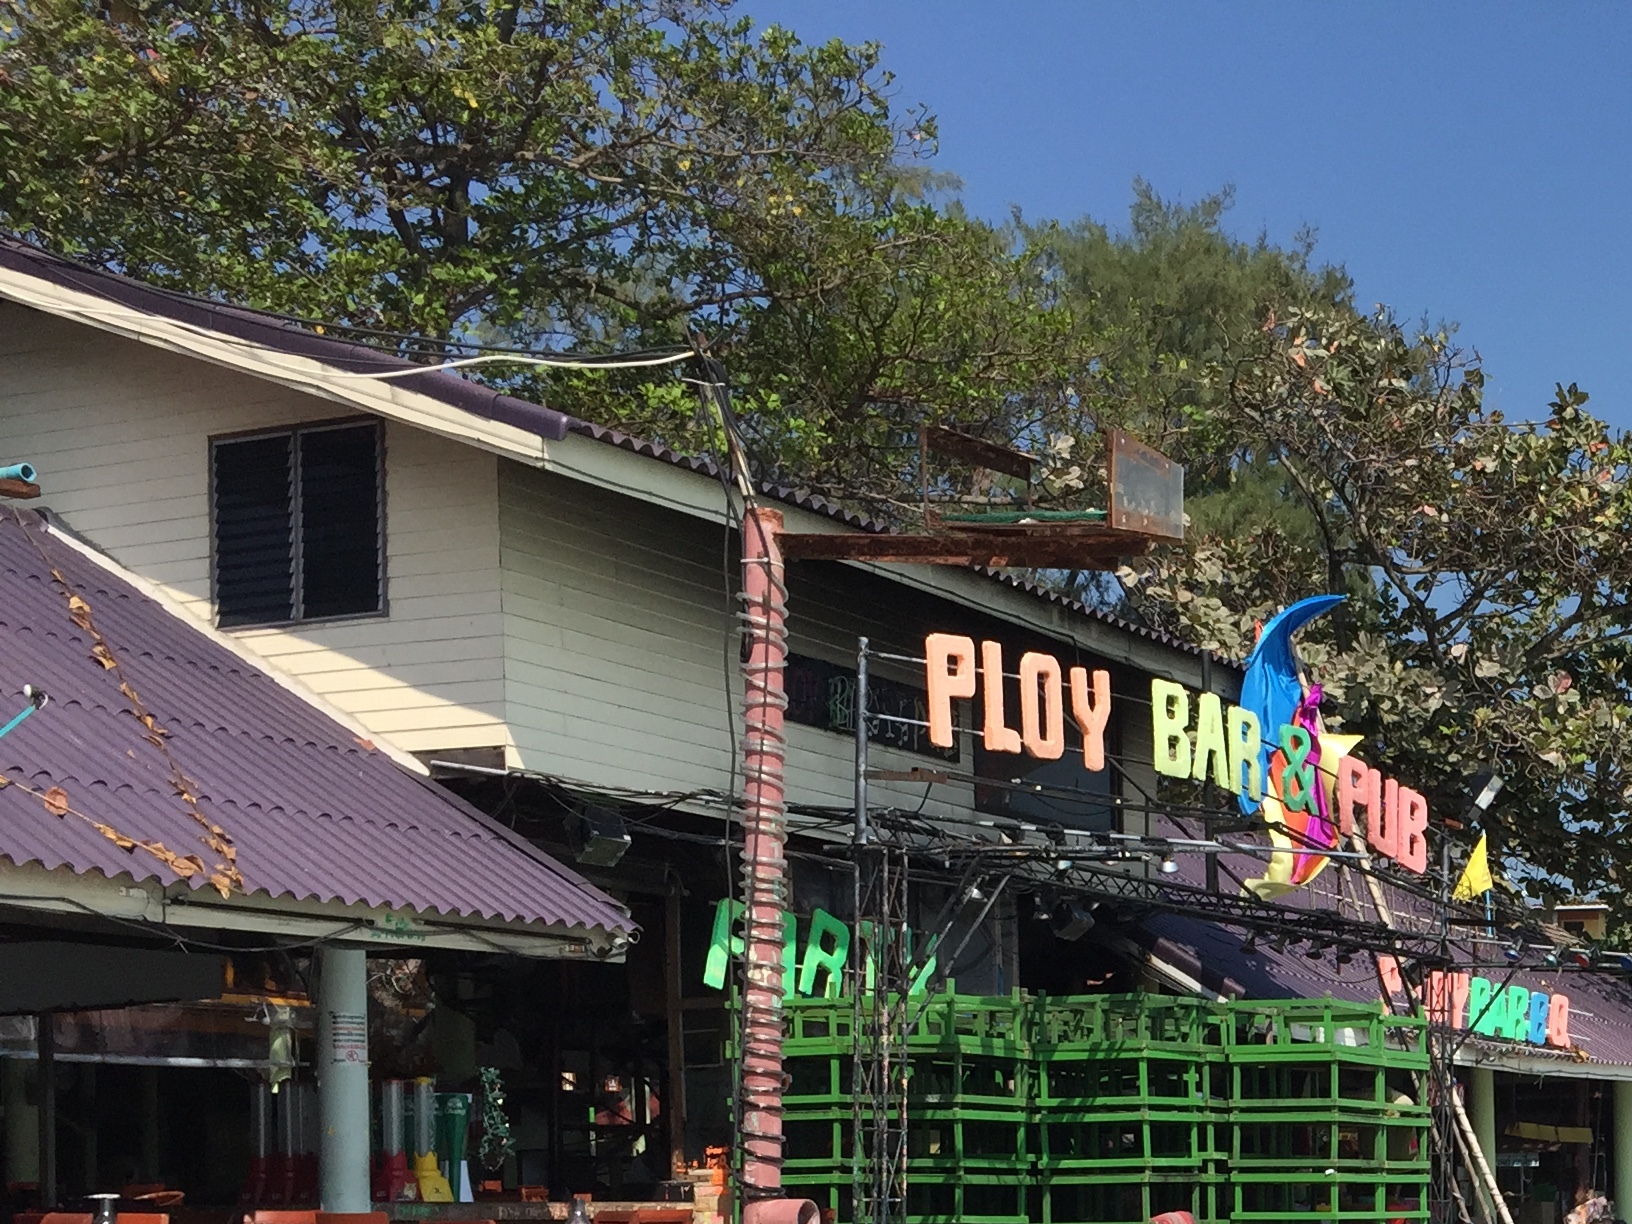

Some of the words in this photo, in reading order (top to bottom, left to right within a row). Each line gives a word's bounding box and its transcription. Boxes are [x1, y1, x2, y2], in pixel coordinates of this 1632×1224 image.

[925, 633, 1111, 772] PLOY
[1151, 678, 1262, 802] BAR
[1279, 723, 1318, 815] &
[1337, 754, 1428, 875] PUB
[703, 897, 938, 1000] PRTY
[1376, 953, 1470, 1029] POY
